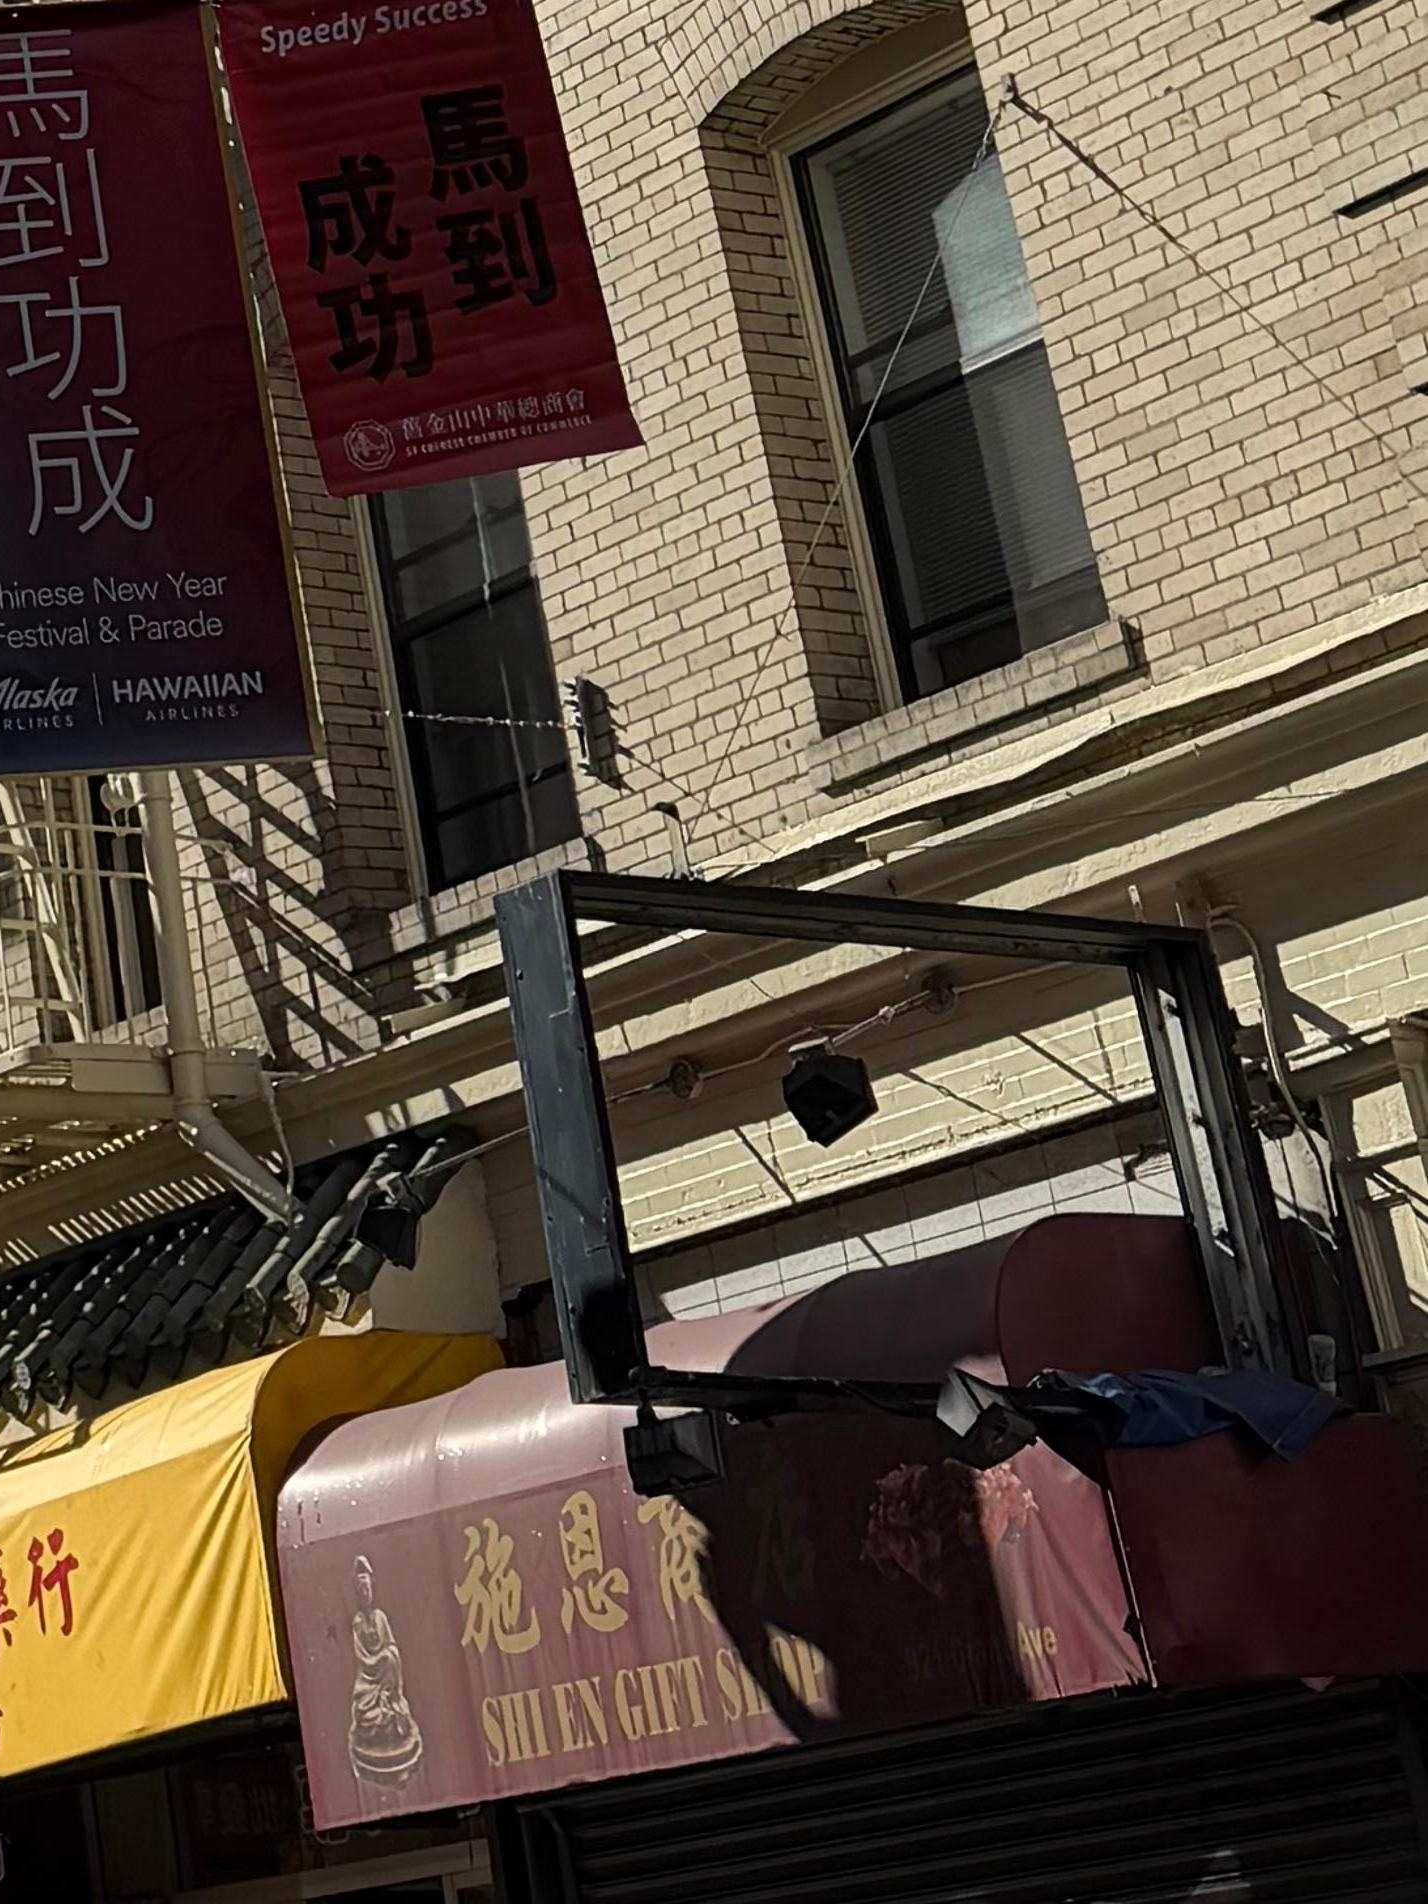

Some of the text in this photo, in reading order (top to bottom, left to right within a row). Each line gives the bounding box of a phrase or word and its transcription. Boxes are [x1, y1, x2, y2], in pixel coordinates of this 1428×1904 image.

[260, 12, 368, 56] Speedy
[92, 574, 159, 604] New
[166, 569, 228, 599] Year
[98, 616, 122, 645] &
[129, 610, 225, 642] Parade
[112, 670, 264, 702] HAWAIIAN
[144, 703, 241, 723] AIRLINES
[1015, 1620, 1058, 1661] Ave
[481, 1683, 548, 1770] SHI
[556, 1676, 610, 1752] EN
[615, 1660, 710, 1741] GIFT
